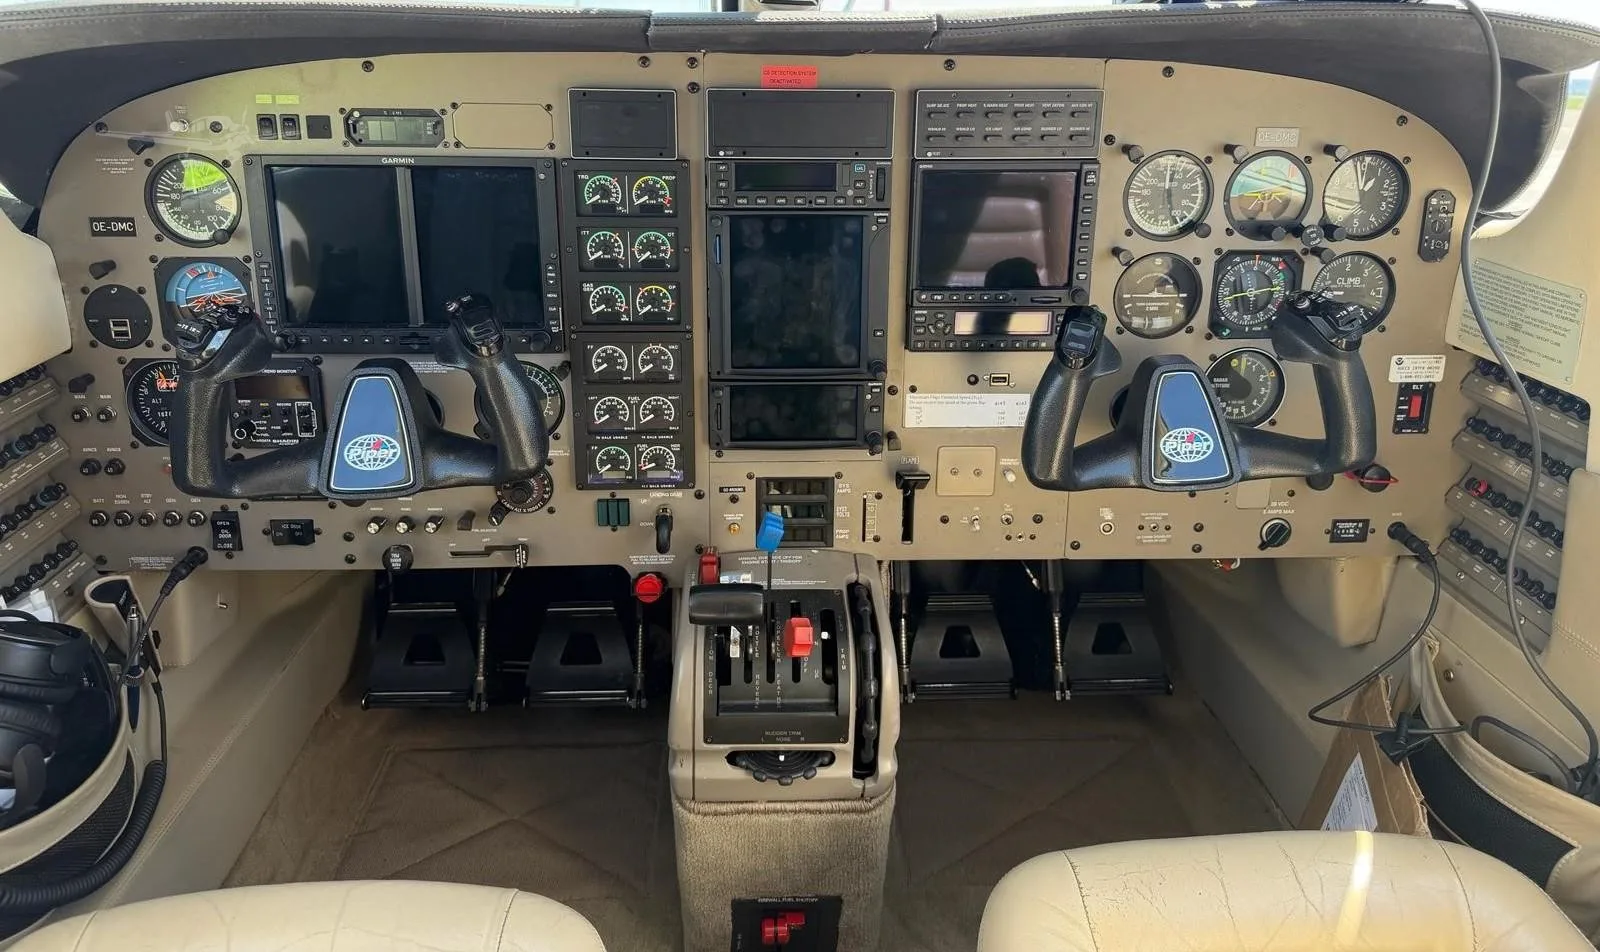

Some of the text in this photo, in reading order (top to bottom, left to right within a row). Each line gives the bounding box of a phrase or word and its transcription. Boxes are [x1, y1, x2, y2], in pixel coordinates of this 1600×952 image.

[1378, 168, 1381, 176] 1
[1384, 180, 1390, 188] 2
[92, 222, 134, 232] OE-DMC
[1166, 441, 1209, 453] Piper
[349, 448, 398, 460] Piper
[502, 500, 514, 510] CABIN
